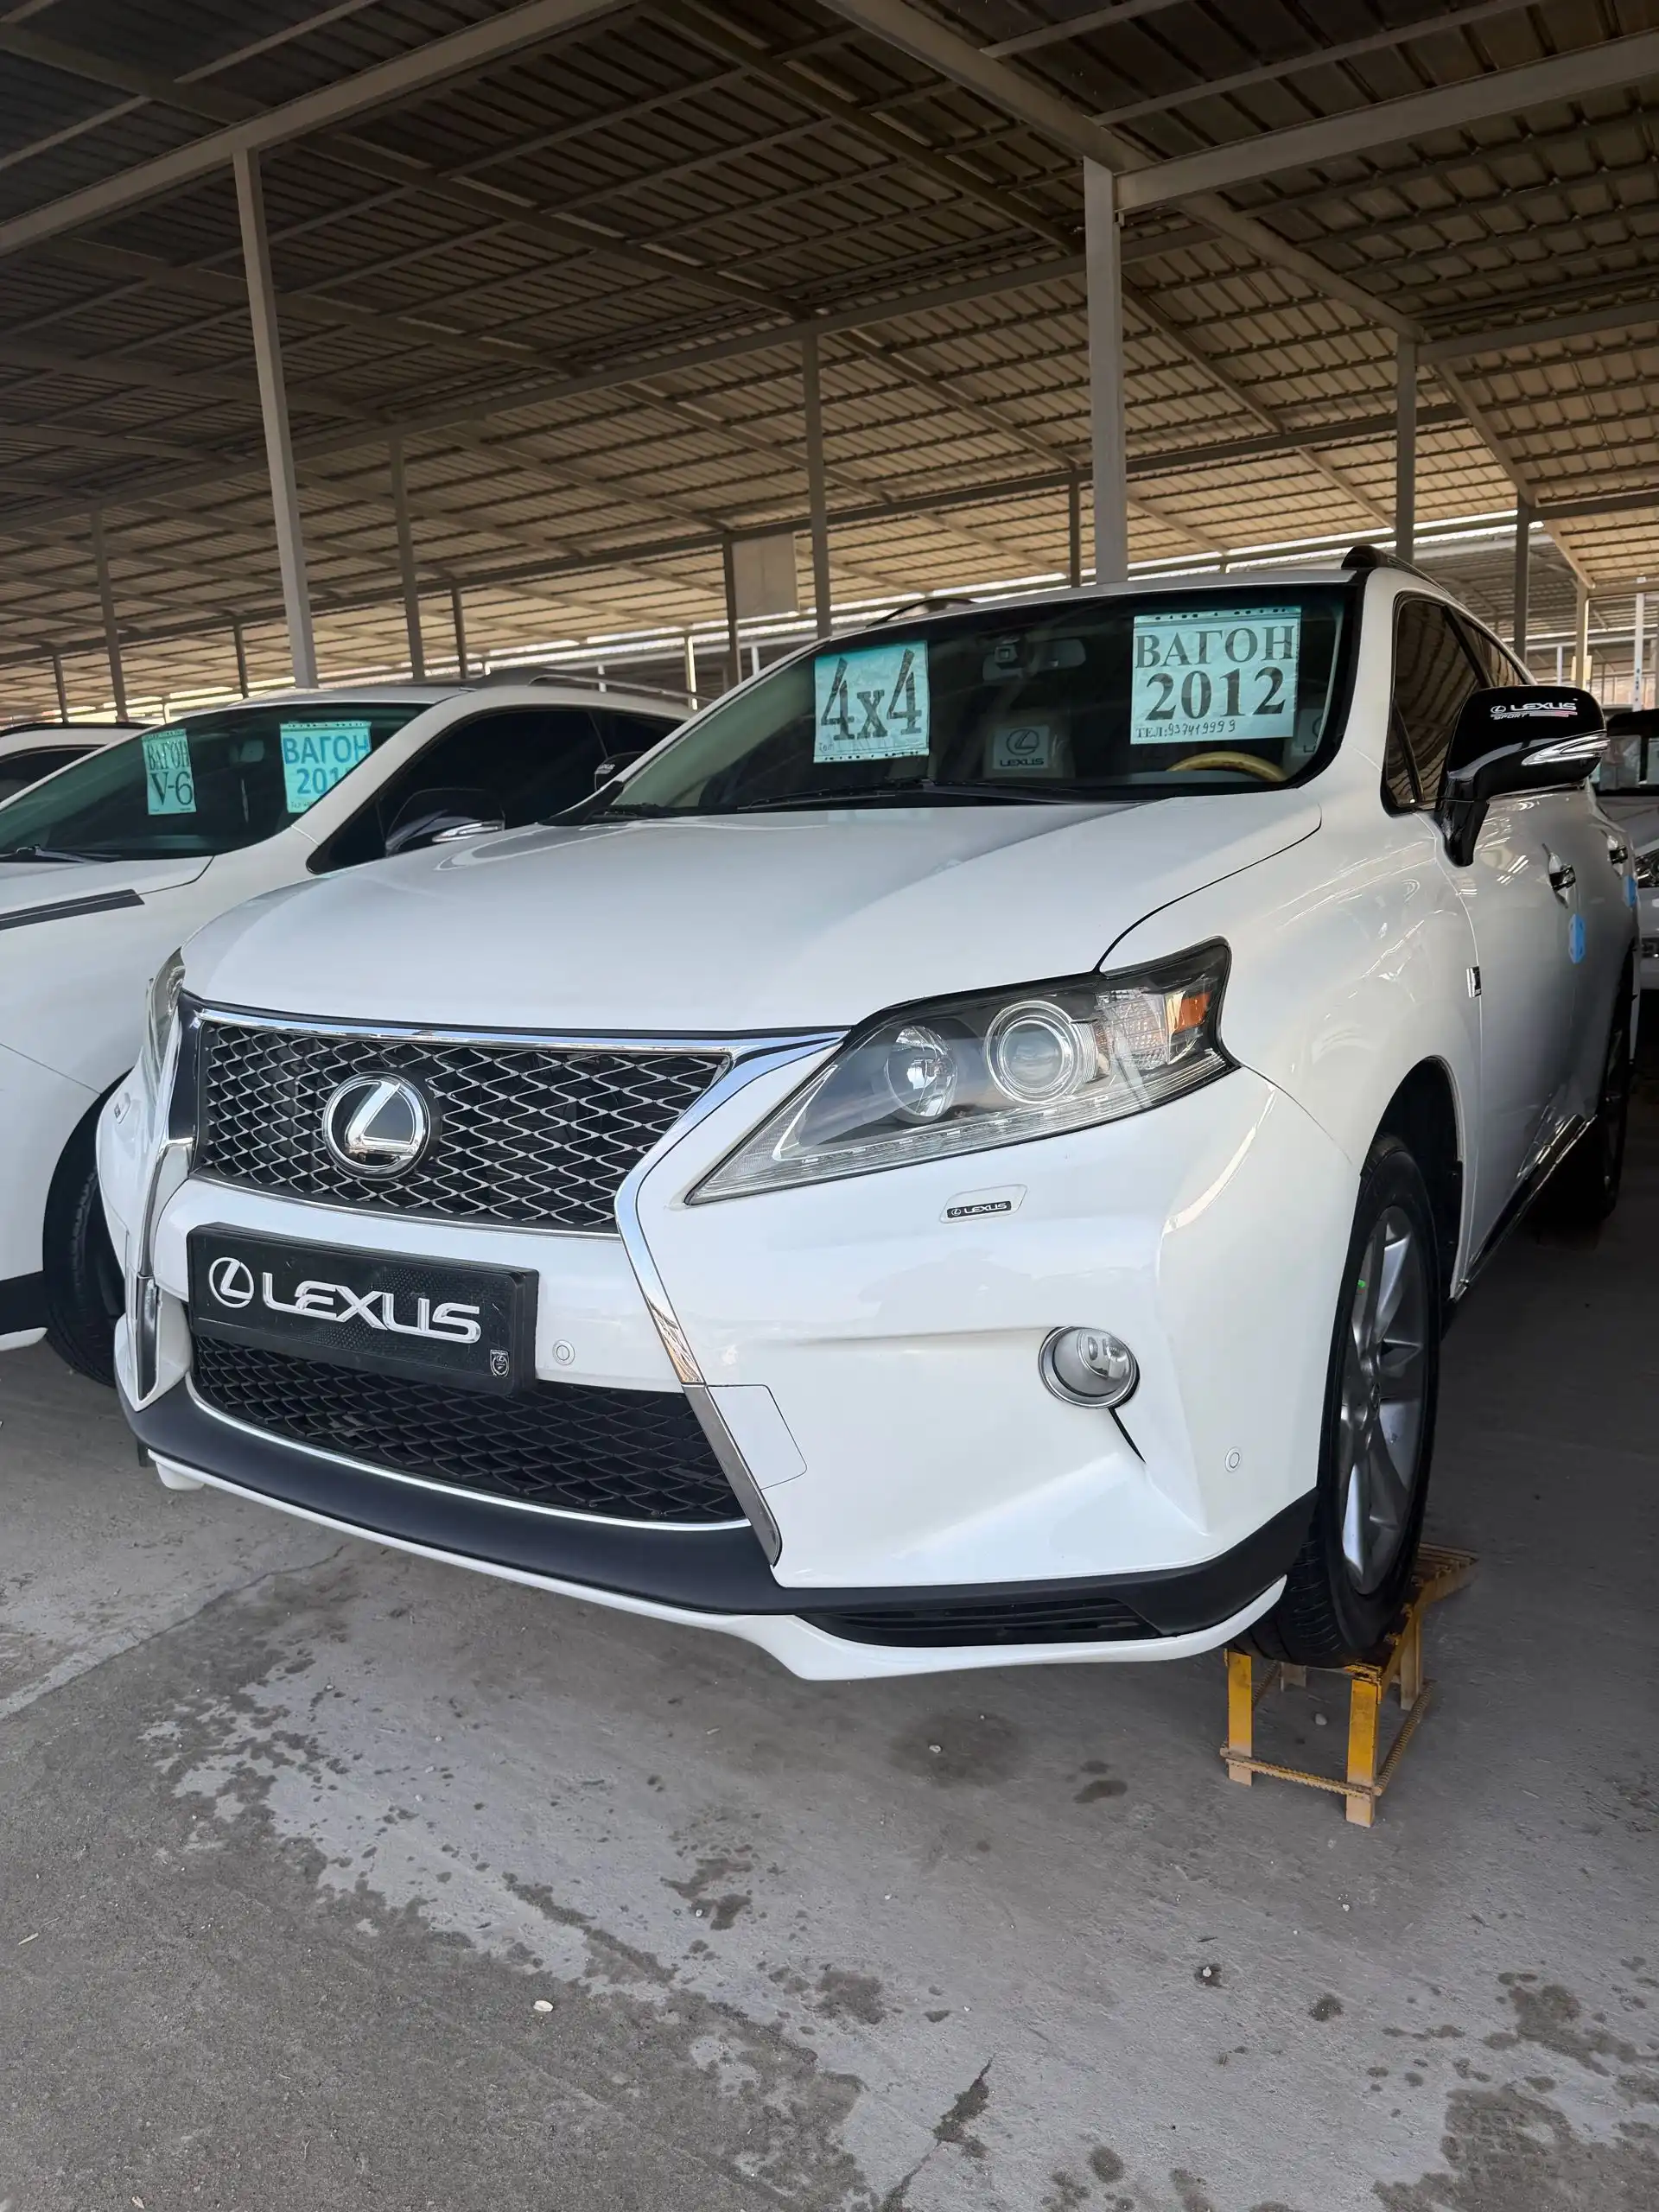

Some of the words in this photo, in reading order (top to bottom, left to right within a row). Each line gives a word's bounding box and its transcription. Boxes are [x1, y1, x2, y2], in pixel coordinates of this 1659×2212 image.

[1135, 626, 1294, 668] ВАГОН
[1145, 667, 1286, 721] 2012
[1510, 702, 1577, 711] LEXUS
[146, 740, 189, 770] ВАГОН
[283, 734, 367, 764] ВАГОН
[1000, 758, 1045, 767] LEXUS
[149, 771, 193, 806] V-6
[296, 766, 352, 794] 201
[963, 1203, 1007, 1214] LEXUS
[263, 1272, 481, 1344] LEXUS
